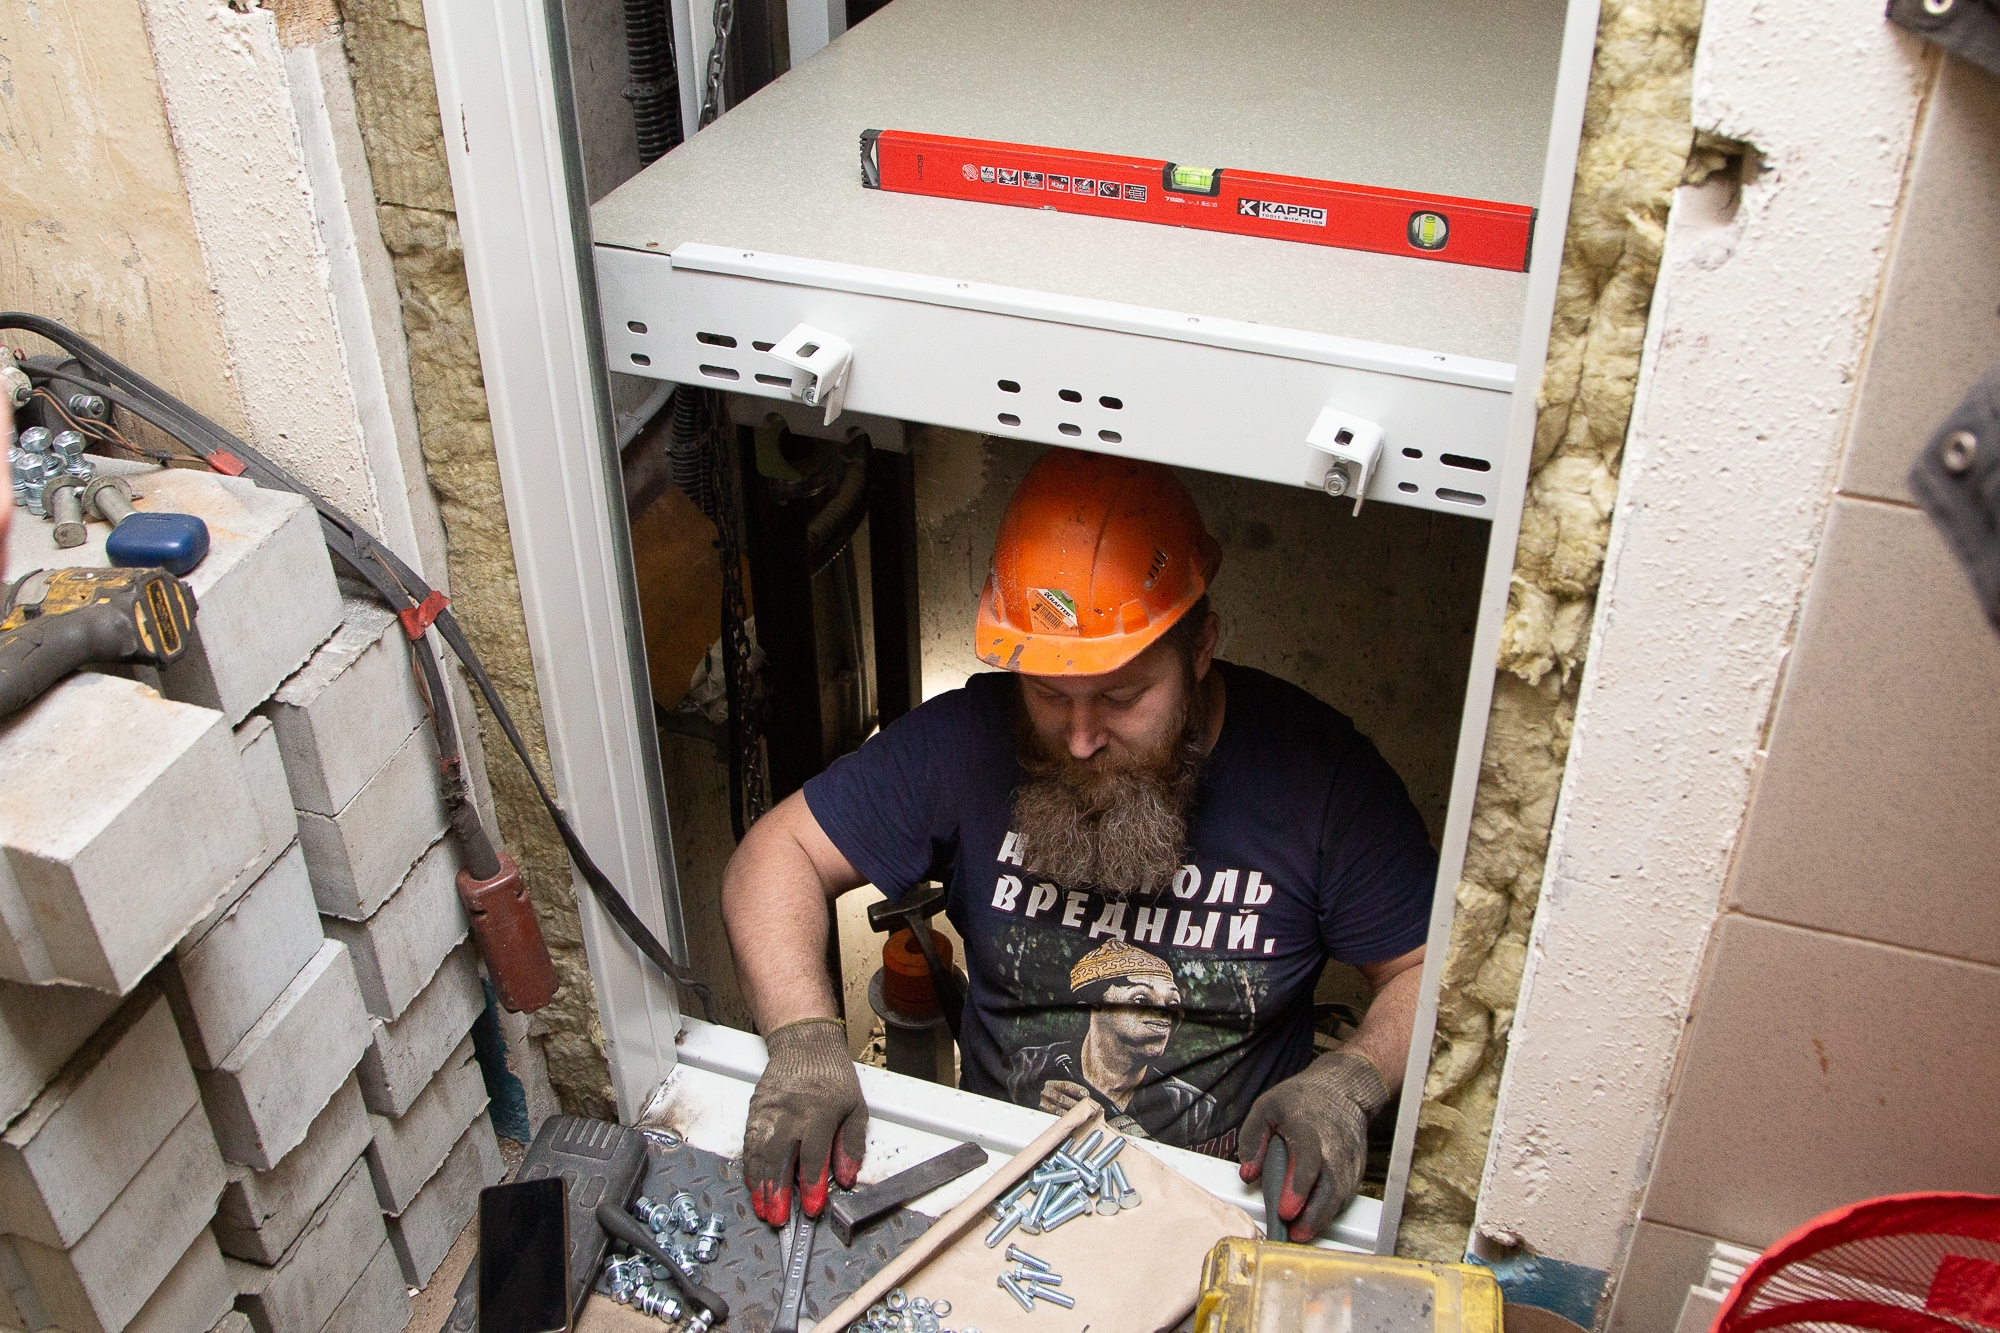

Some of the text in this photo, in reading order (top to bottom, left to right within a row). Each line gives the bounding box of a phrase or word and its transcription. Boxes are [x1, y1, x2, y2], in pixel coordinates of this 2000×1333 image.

[1261, 202, 1323, 220] KAPRO
[1301, 217, 1324, 225] VISION
[997, 831, 1274, 905] АОЛЬ
[991, 874, 1276, 954] ВРЕДНЫЙ,
